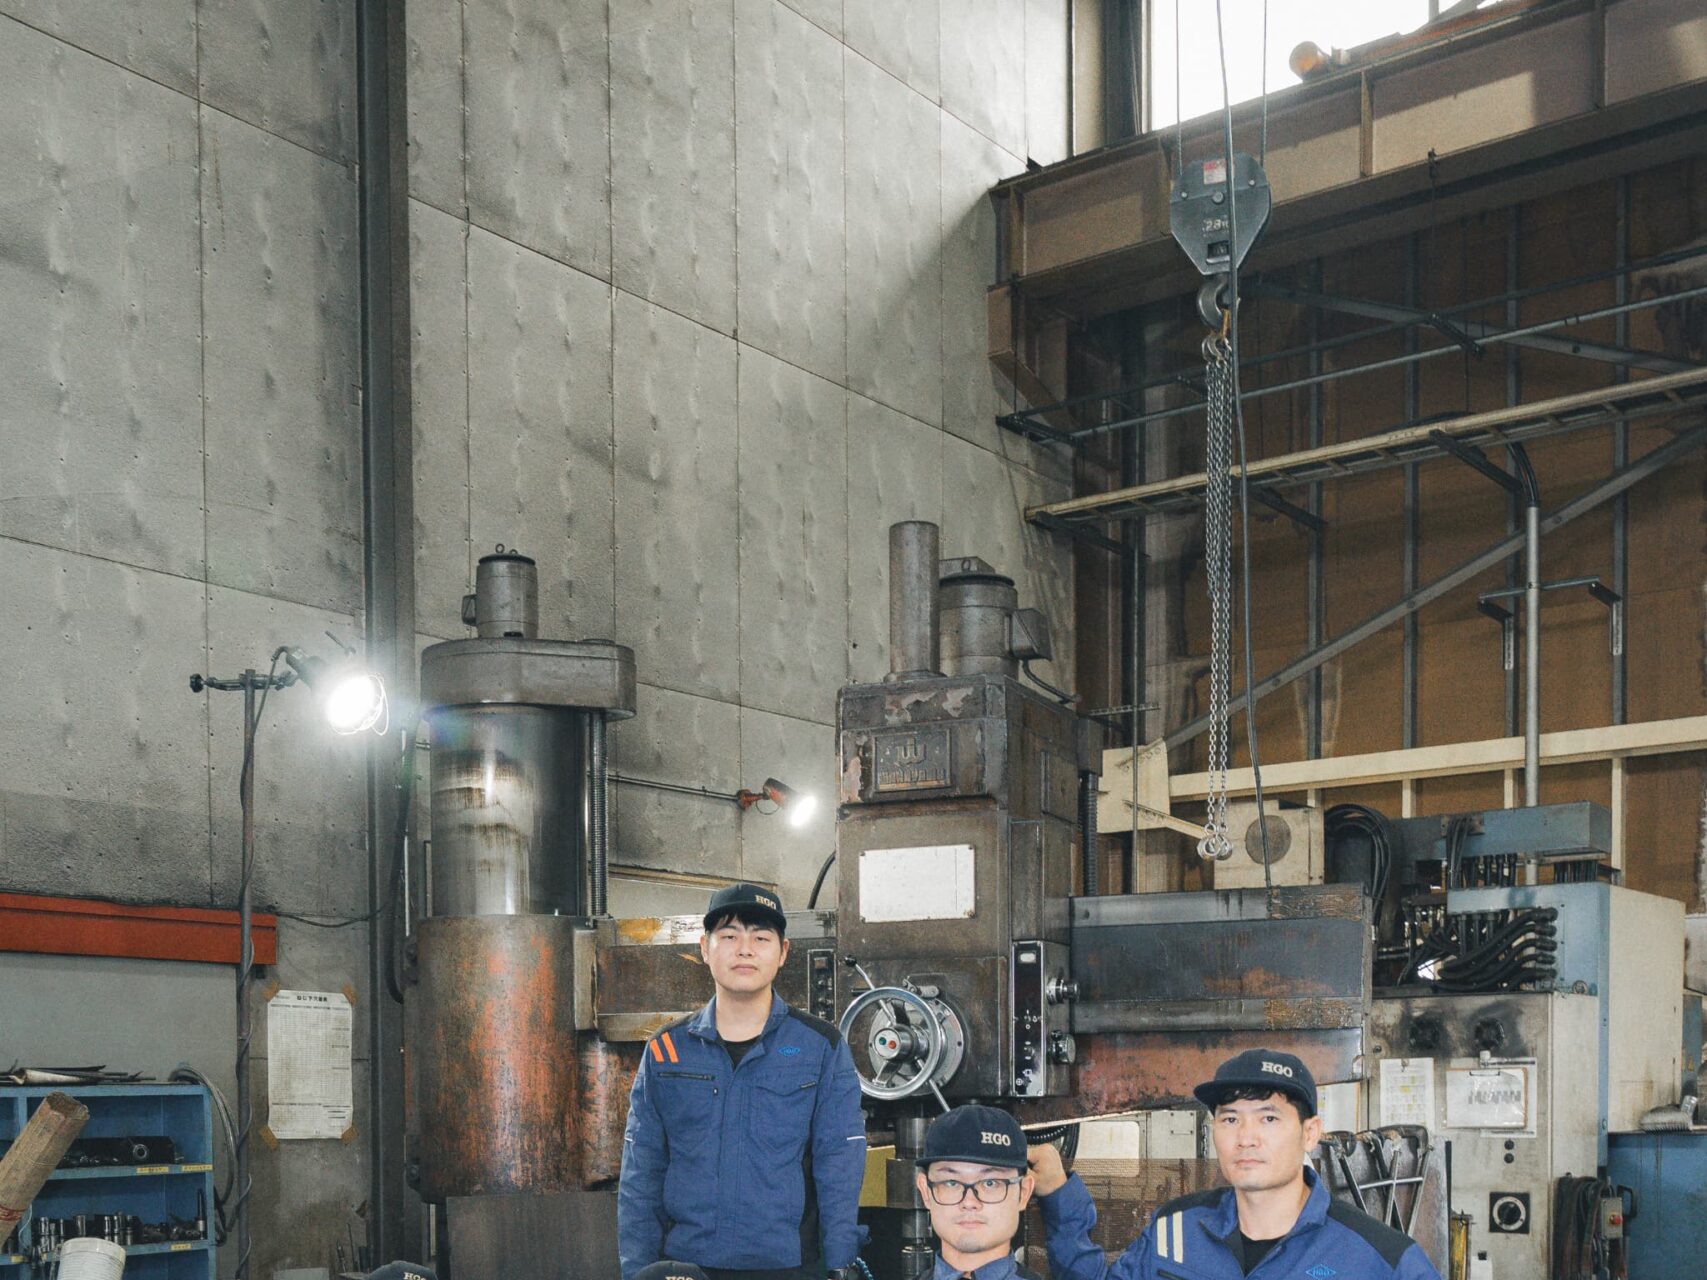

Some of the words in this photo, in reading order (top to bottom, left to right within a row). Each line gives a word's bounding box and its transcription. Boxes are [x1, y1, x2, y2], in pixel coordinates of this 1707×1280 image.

[755, 895, 776, 910] HGO
[1262, 1062, 1293, 1077] HGO
[980, 1131, 1011, 1146] HGO
